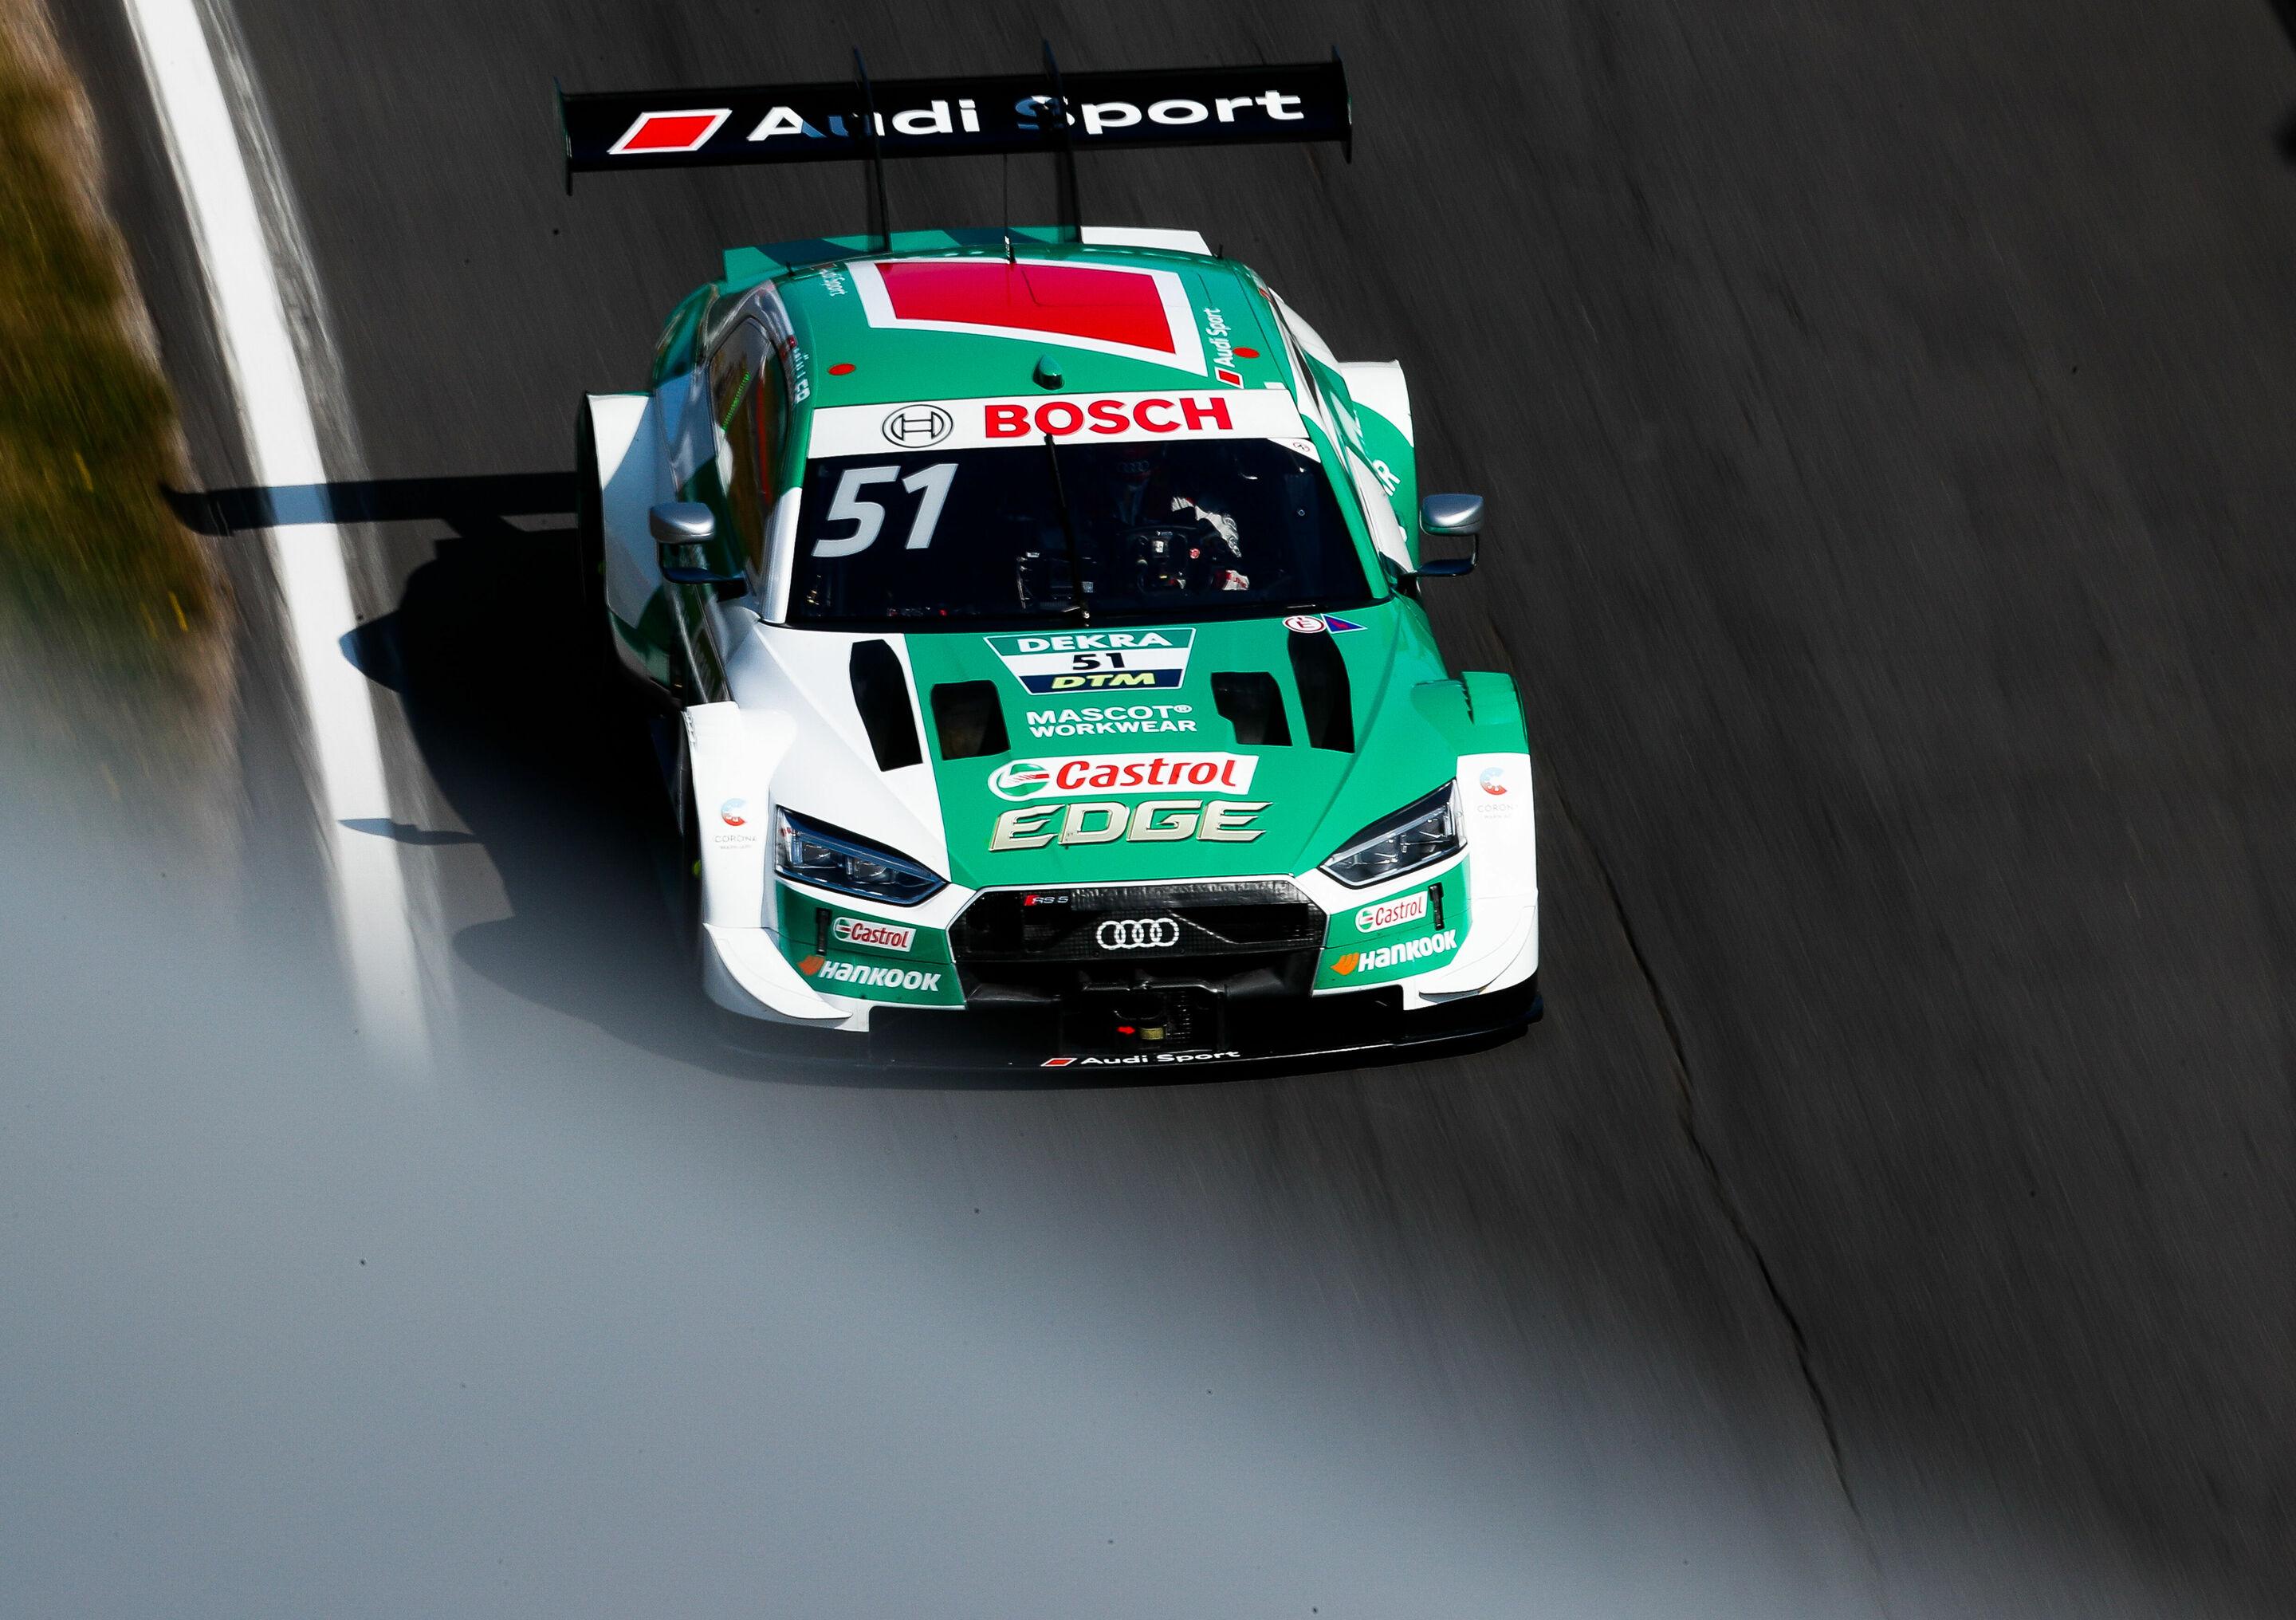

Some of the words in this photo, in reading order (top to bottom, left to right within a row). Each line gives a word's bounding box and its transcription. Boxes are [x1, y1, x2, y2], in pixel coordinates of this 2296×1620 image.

[746, 99, 981, 141] Audi
[1203, 308, 1231, 336] Sport
[1209, 337, 1235, 368] Audi
[985, 397, 1234, 438] BOSCH
[811, 463, 958, 557] 51
[1017, 631, 1174, 652] DEKRA
[1072, 652, 1126, 670] 51
[1051, 672, 1156, 690] DTM
[1028, 720, 1198, 738] WORKWEAR
[1056, 758, 1237, 789] Castrol
[989, 800, 1273, 851] EDGE
[1375, 897, 1423, 926] Castrol
[851, 922, 909, 949] Castrol
[1080, 1056, 1148, 1065] Audi
[1156, 1051, 1241, 1064] Sport
